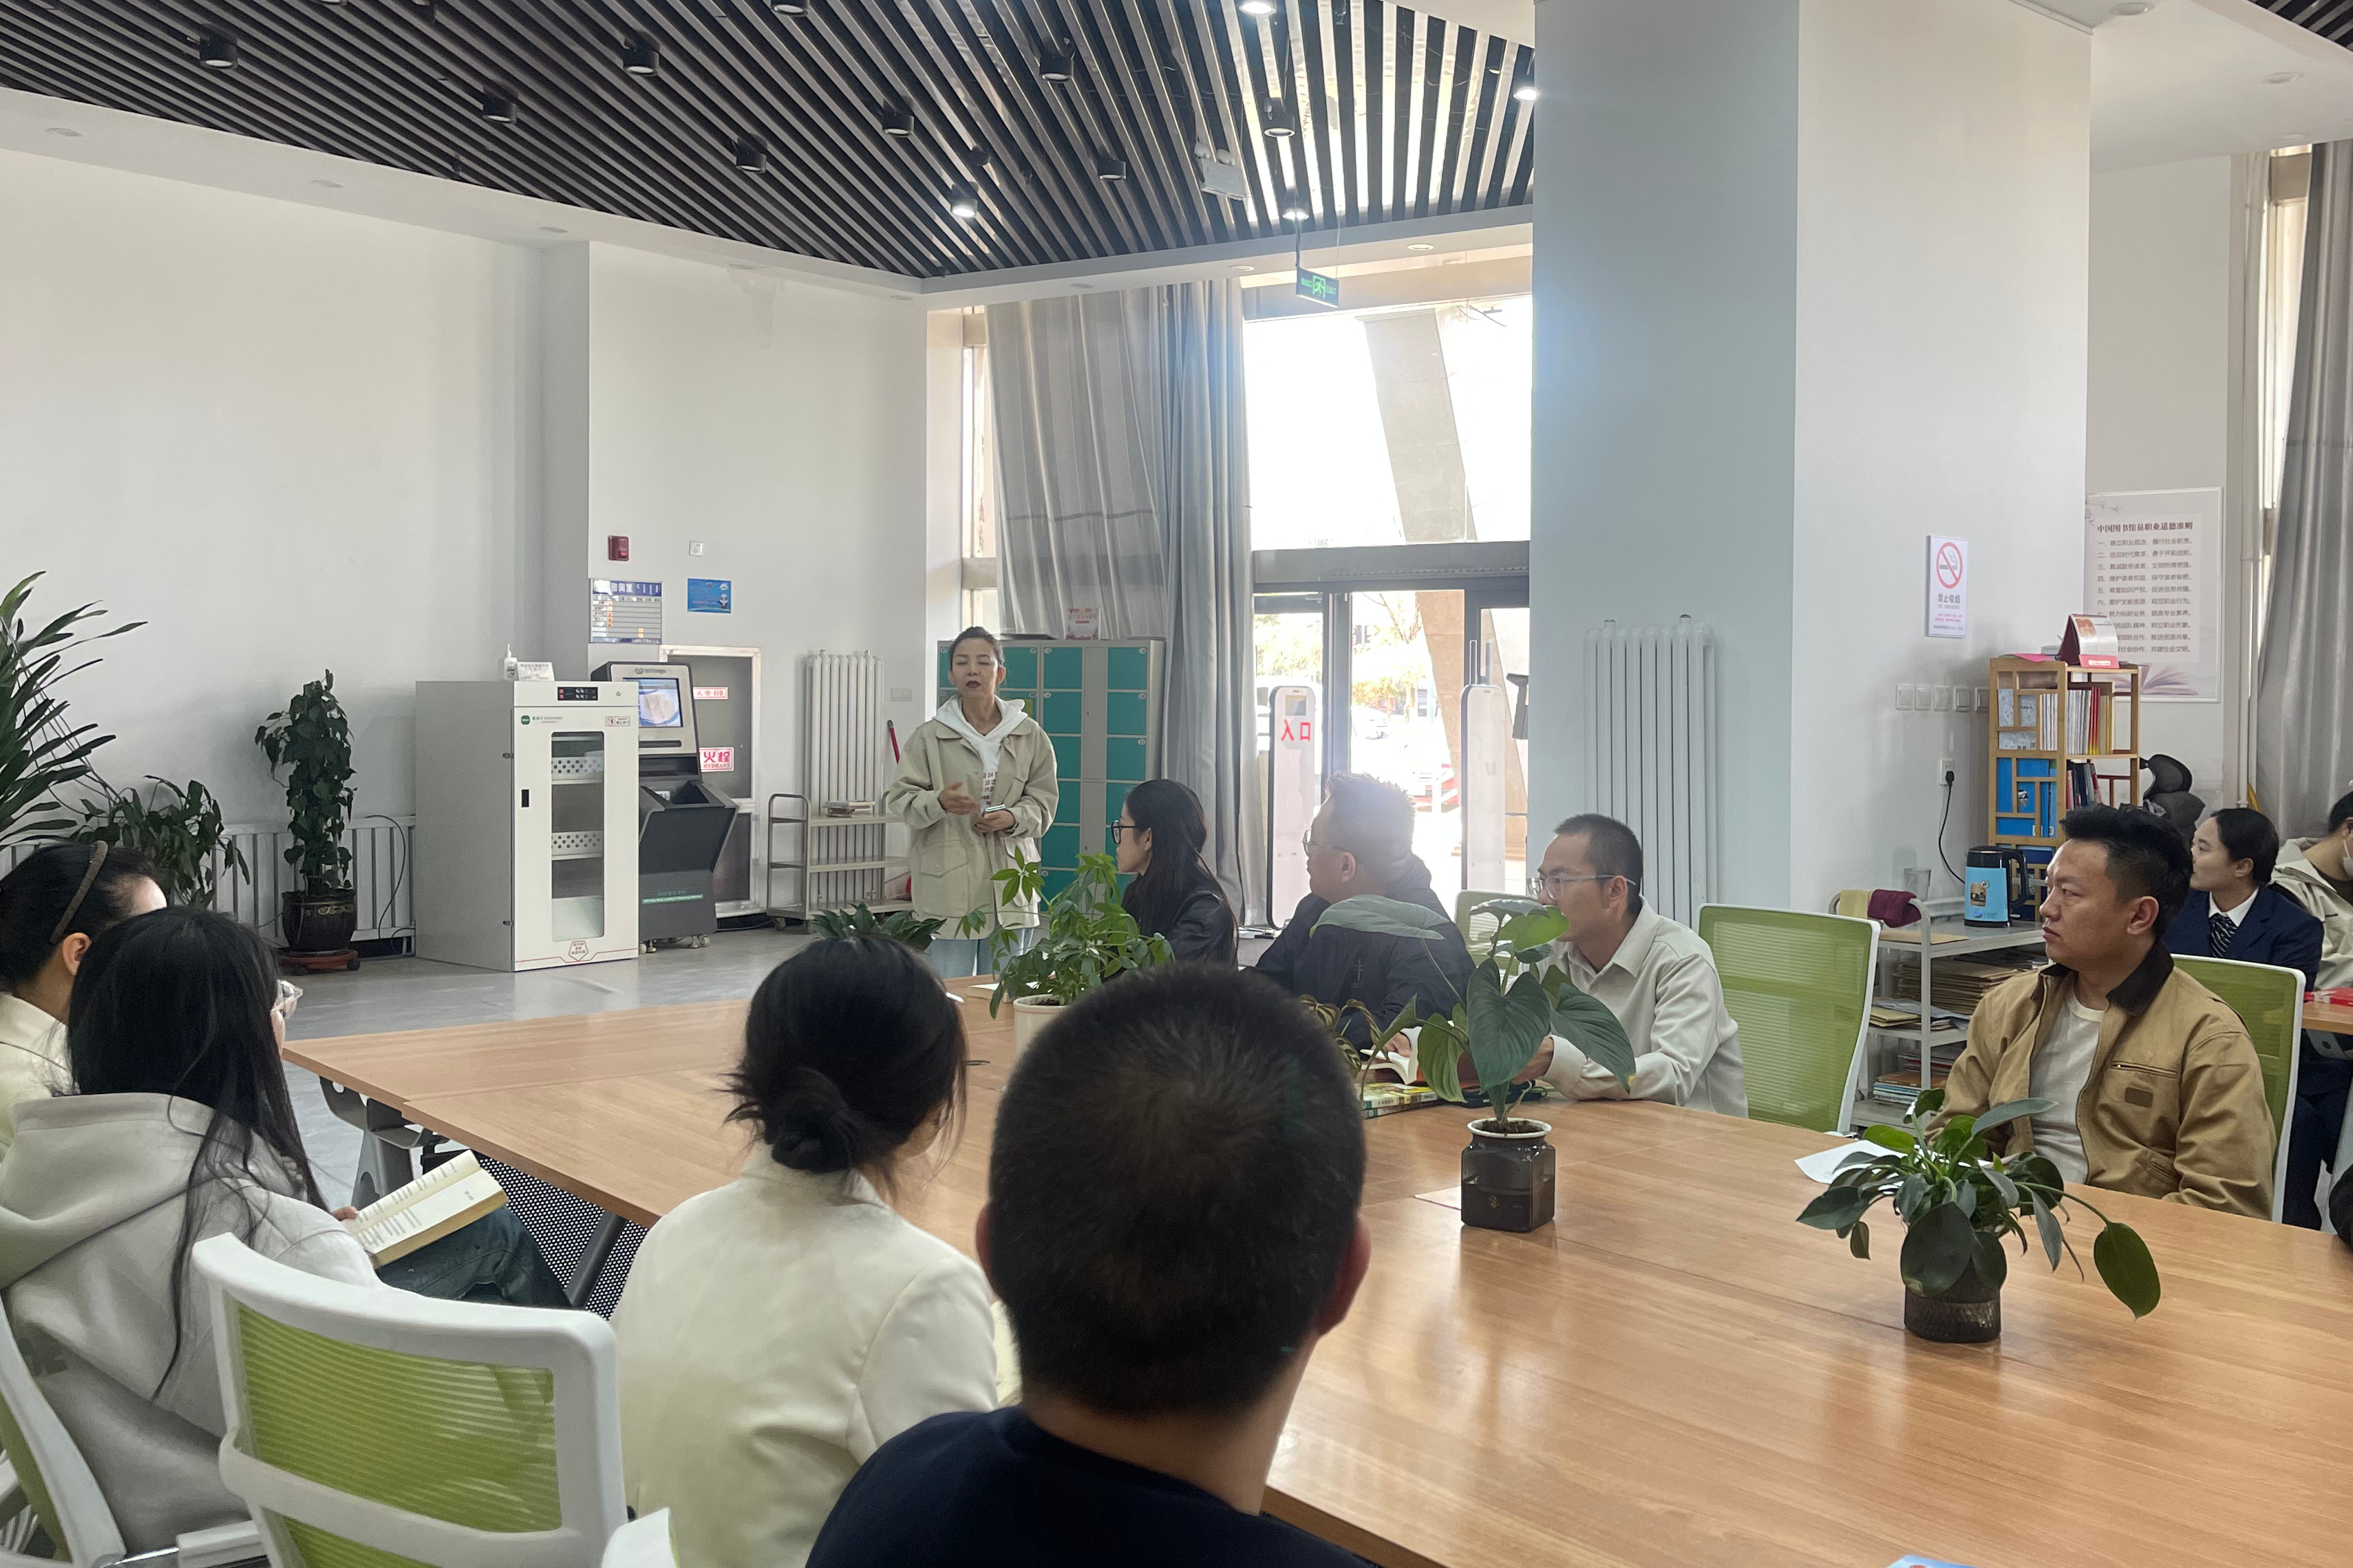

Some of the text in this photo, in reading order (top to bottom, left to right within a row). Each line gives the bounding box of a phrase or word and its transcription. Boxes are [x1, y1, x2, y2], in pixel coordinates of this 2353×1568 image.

[2097, 522, 2193, 533] 中国图书馆员职业道德准则
[1938, 594, 1960, 603] 禁止吸烟
[1281, 719, 1310, 742] 入口
